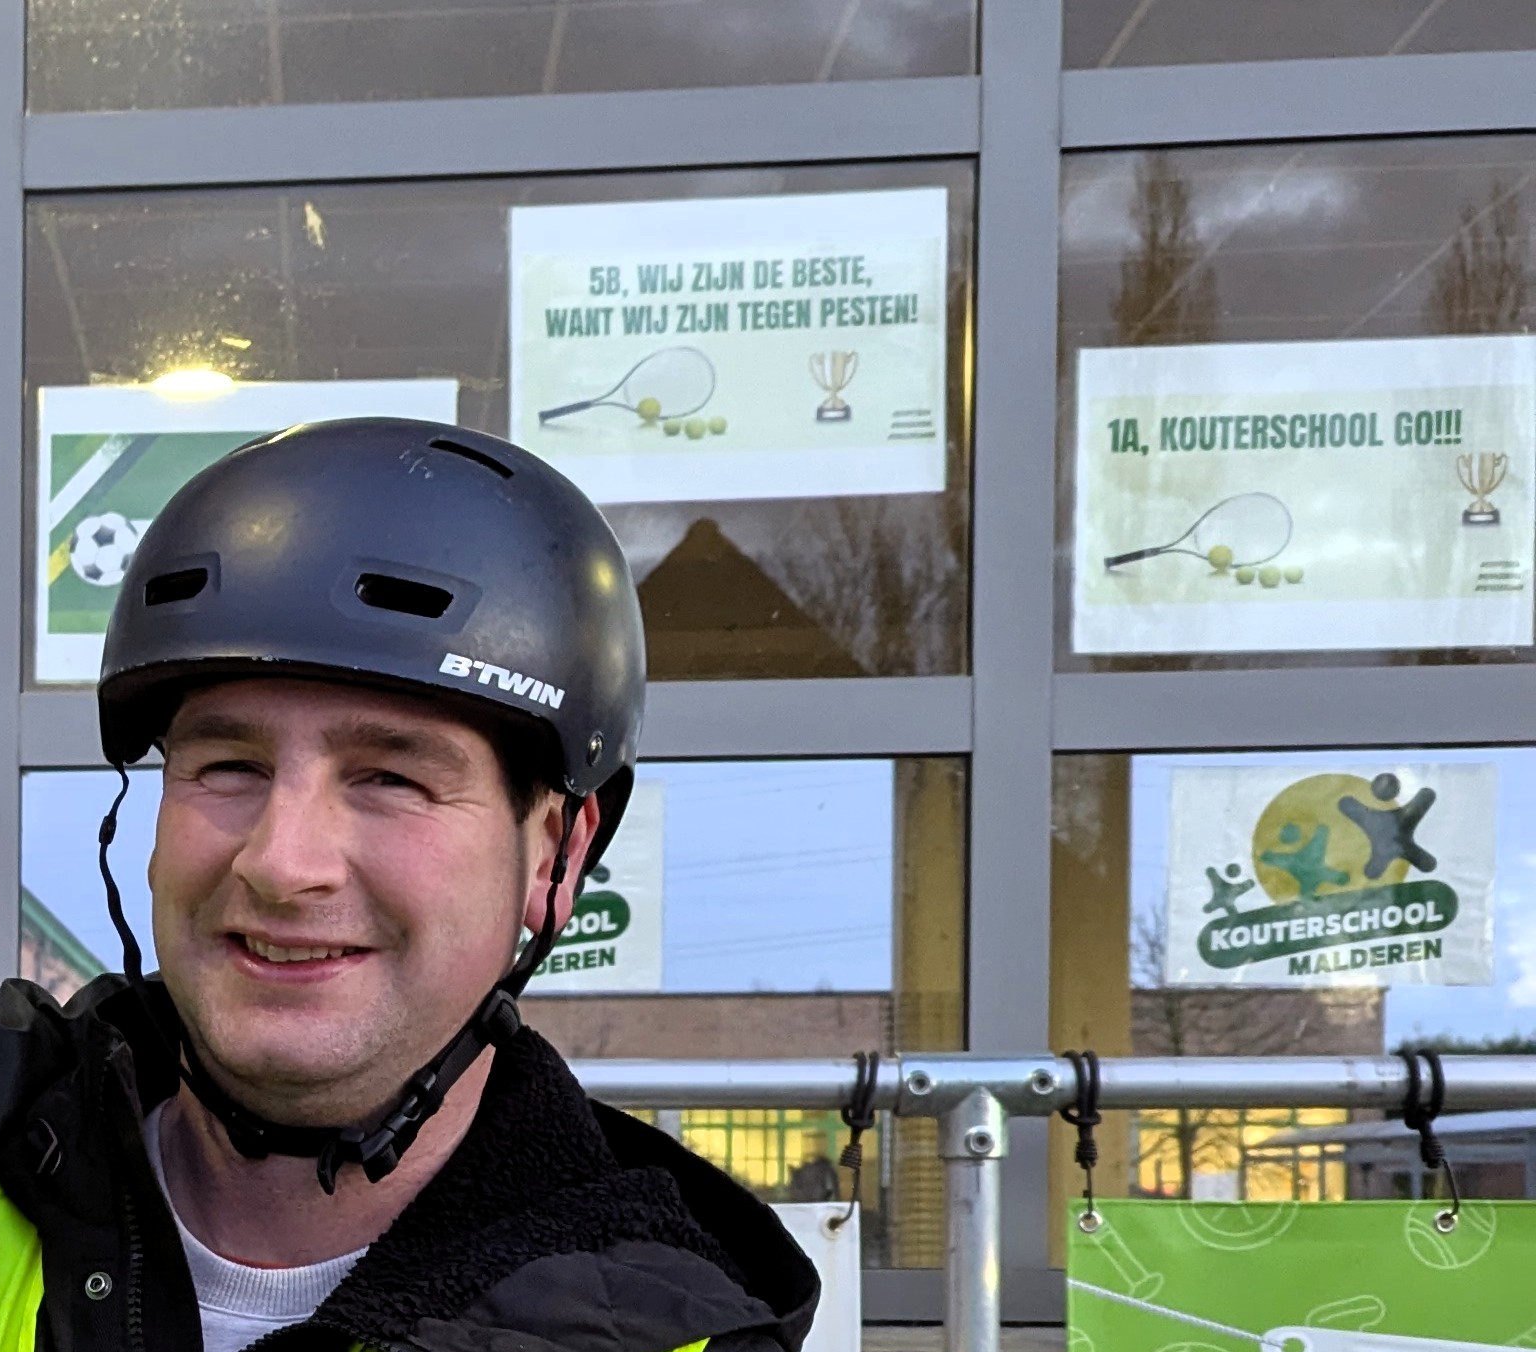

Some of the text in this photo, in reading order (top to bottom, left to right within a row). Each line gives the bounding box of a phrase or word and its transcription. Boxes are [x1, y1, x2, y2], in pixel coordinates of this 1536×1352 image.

[589, 255, 873, 298] 5B, WIJ ZIJN DE BESTE,
[545, 294, 919, 338] WANT WIJ ZIJN TEGEN PESTEN!
[1108, 408, 1463, 456] 1A, KOUTERSCHOOL GO!!!
[1210, 901, 1444, 951] KOUTERSCHOOL
[1287, 938, 1443, 976] MALDEREN
